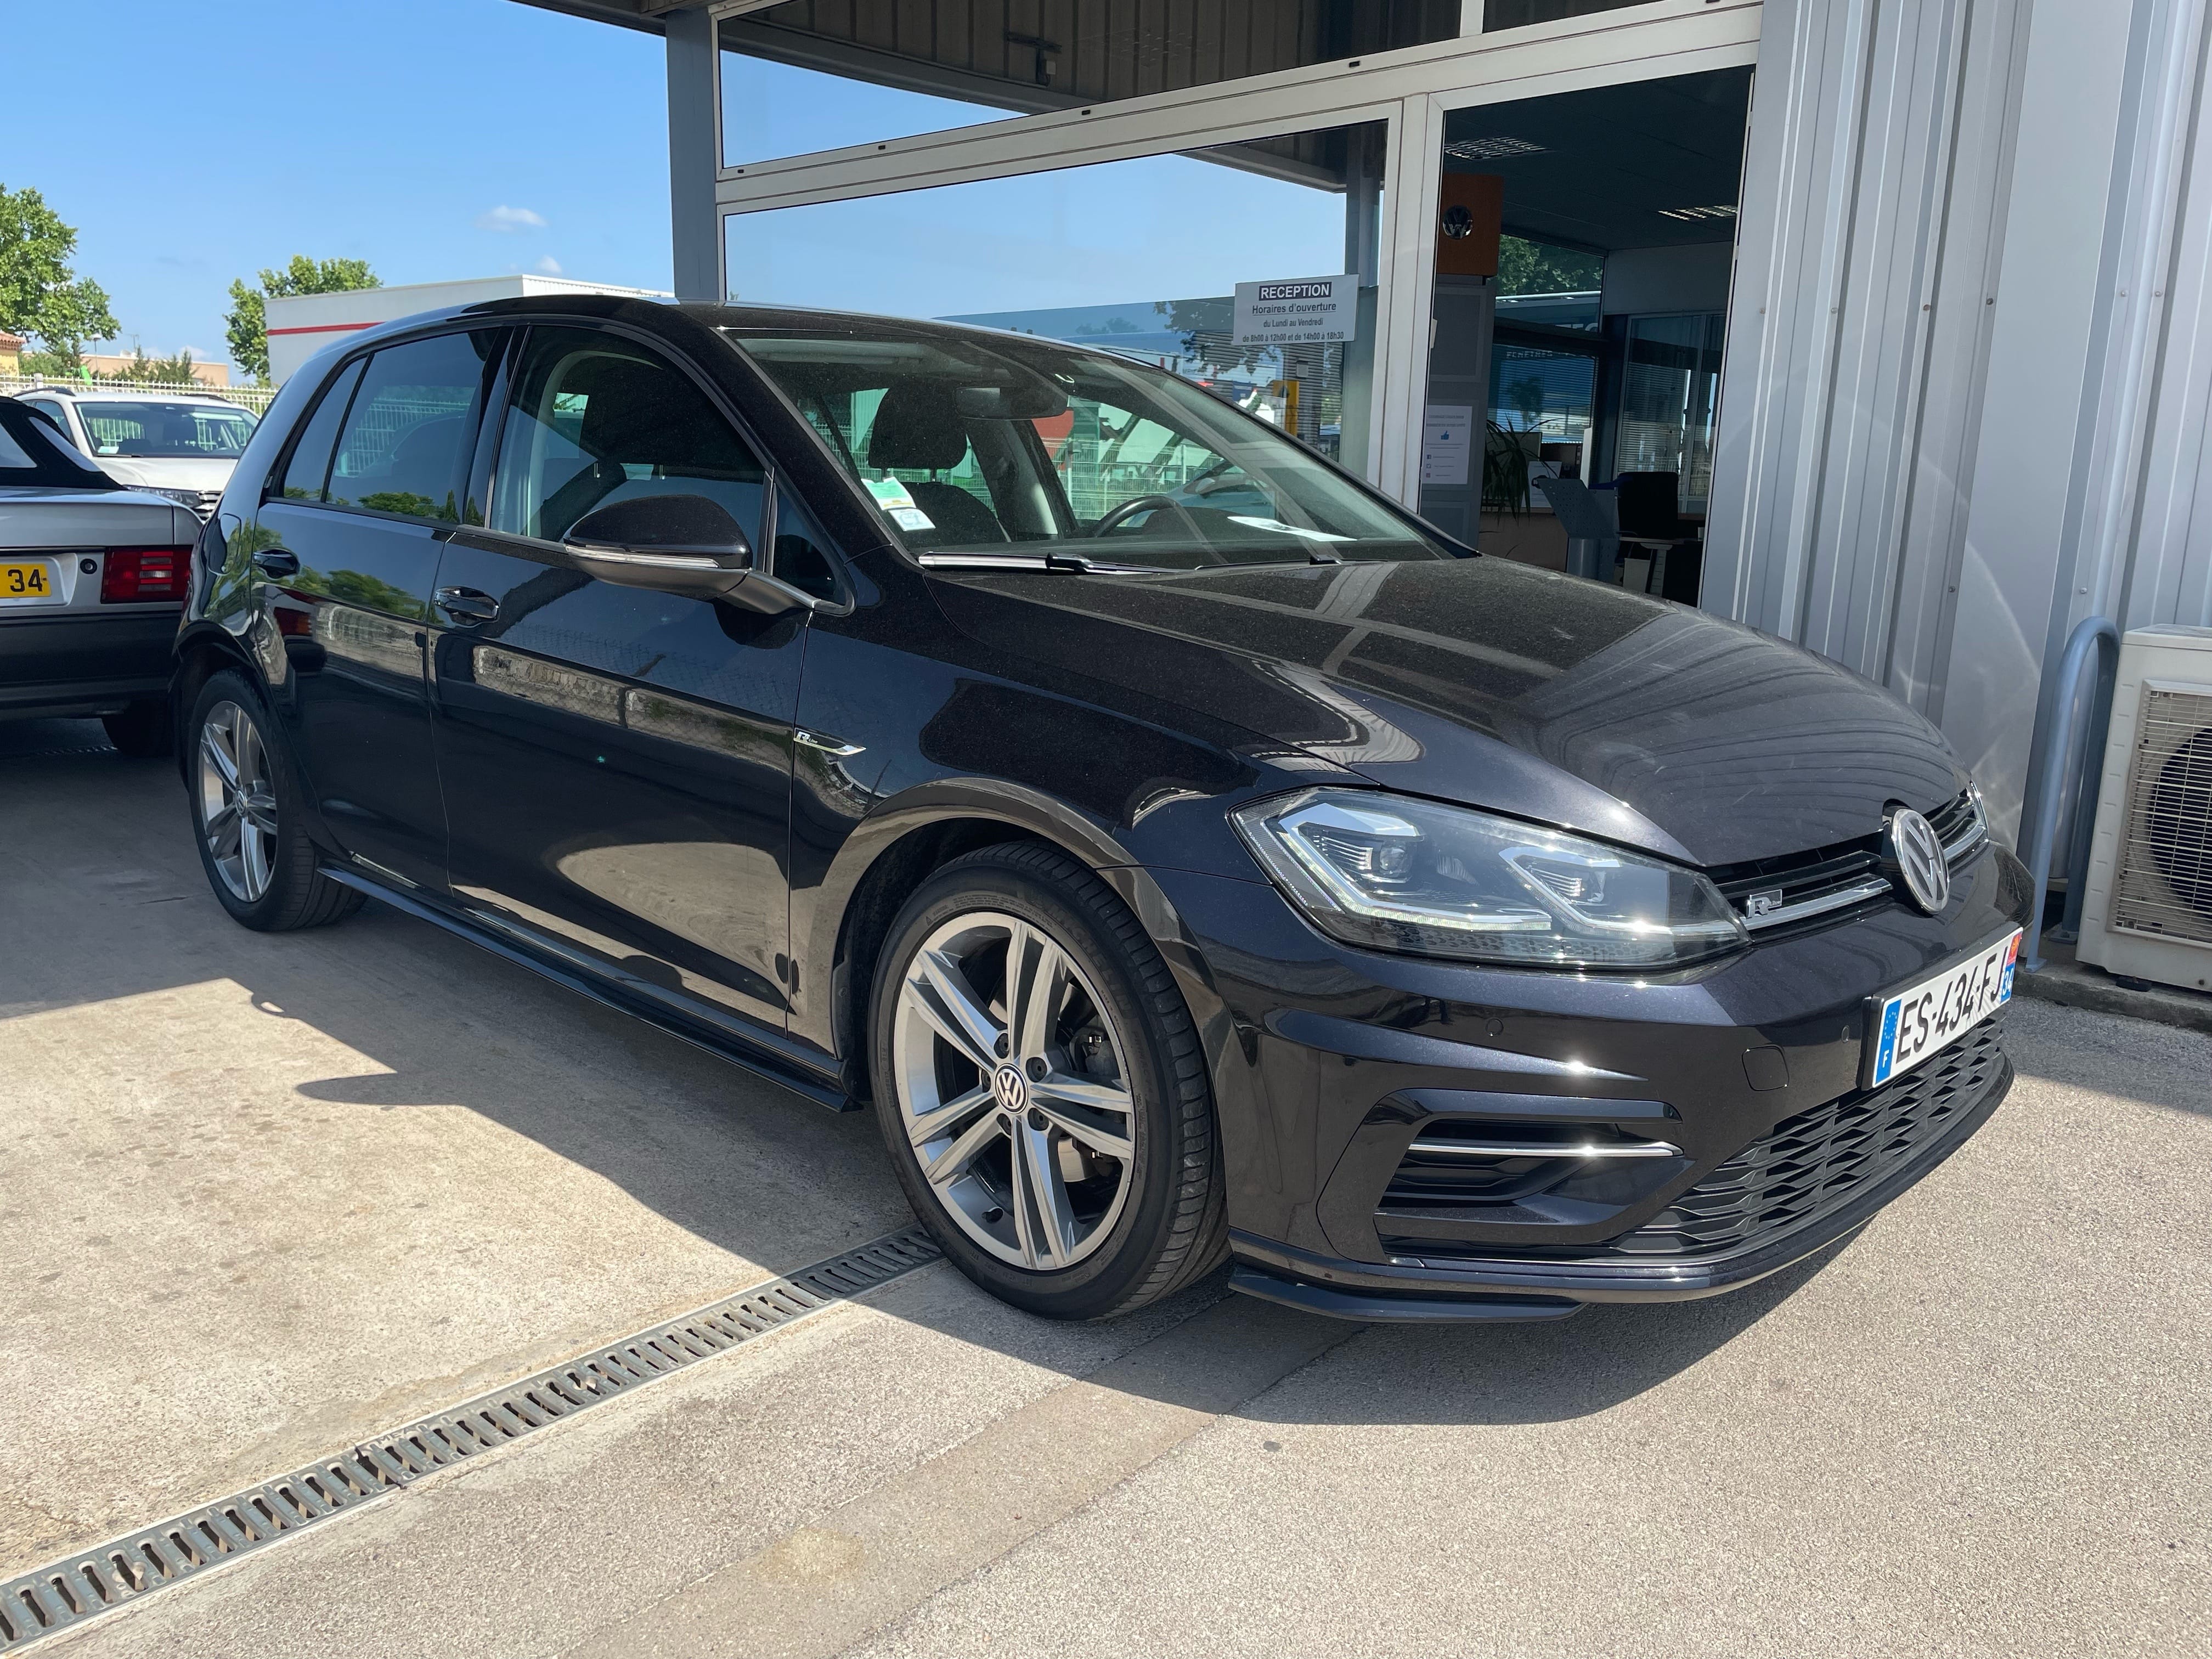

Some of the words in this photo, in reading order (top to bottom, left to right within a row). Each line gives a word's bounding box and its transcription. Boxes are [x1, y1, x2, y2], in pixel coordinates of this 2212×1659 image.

[1260, 284, 1330, 299] RECEPTION
[1252, 304, 1286, 314] Horaires
[1289, 302, 1336, 313] d'ouverture
[1272, 319, 1288, 328] Lundi
[1297, 317, 1323, 326] Vendredi
[1250, 334, 1264, 342] 8h00
[1270, 333, 1286, 341] 12h00
[1294, 332, 1301, 341] de
[1304, 332, 1320, 341] 14h00
[1321, 332, 1325, 340] à
[1327, 331, 1344, 340] 18h30
[8, 568, 43, 592] 34
[2002, 967, 2014, 996] 34
[1895, 946, 2008, 1064] ES-434-FJ
[1882, 1049, 1890, 1068] F
